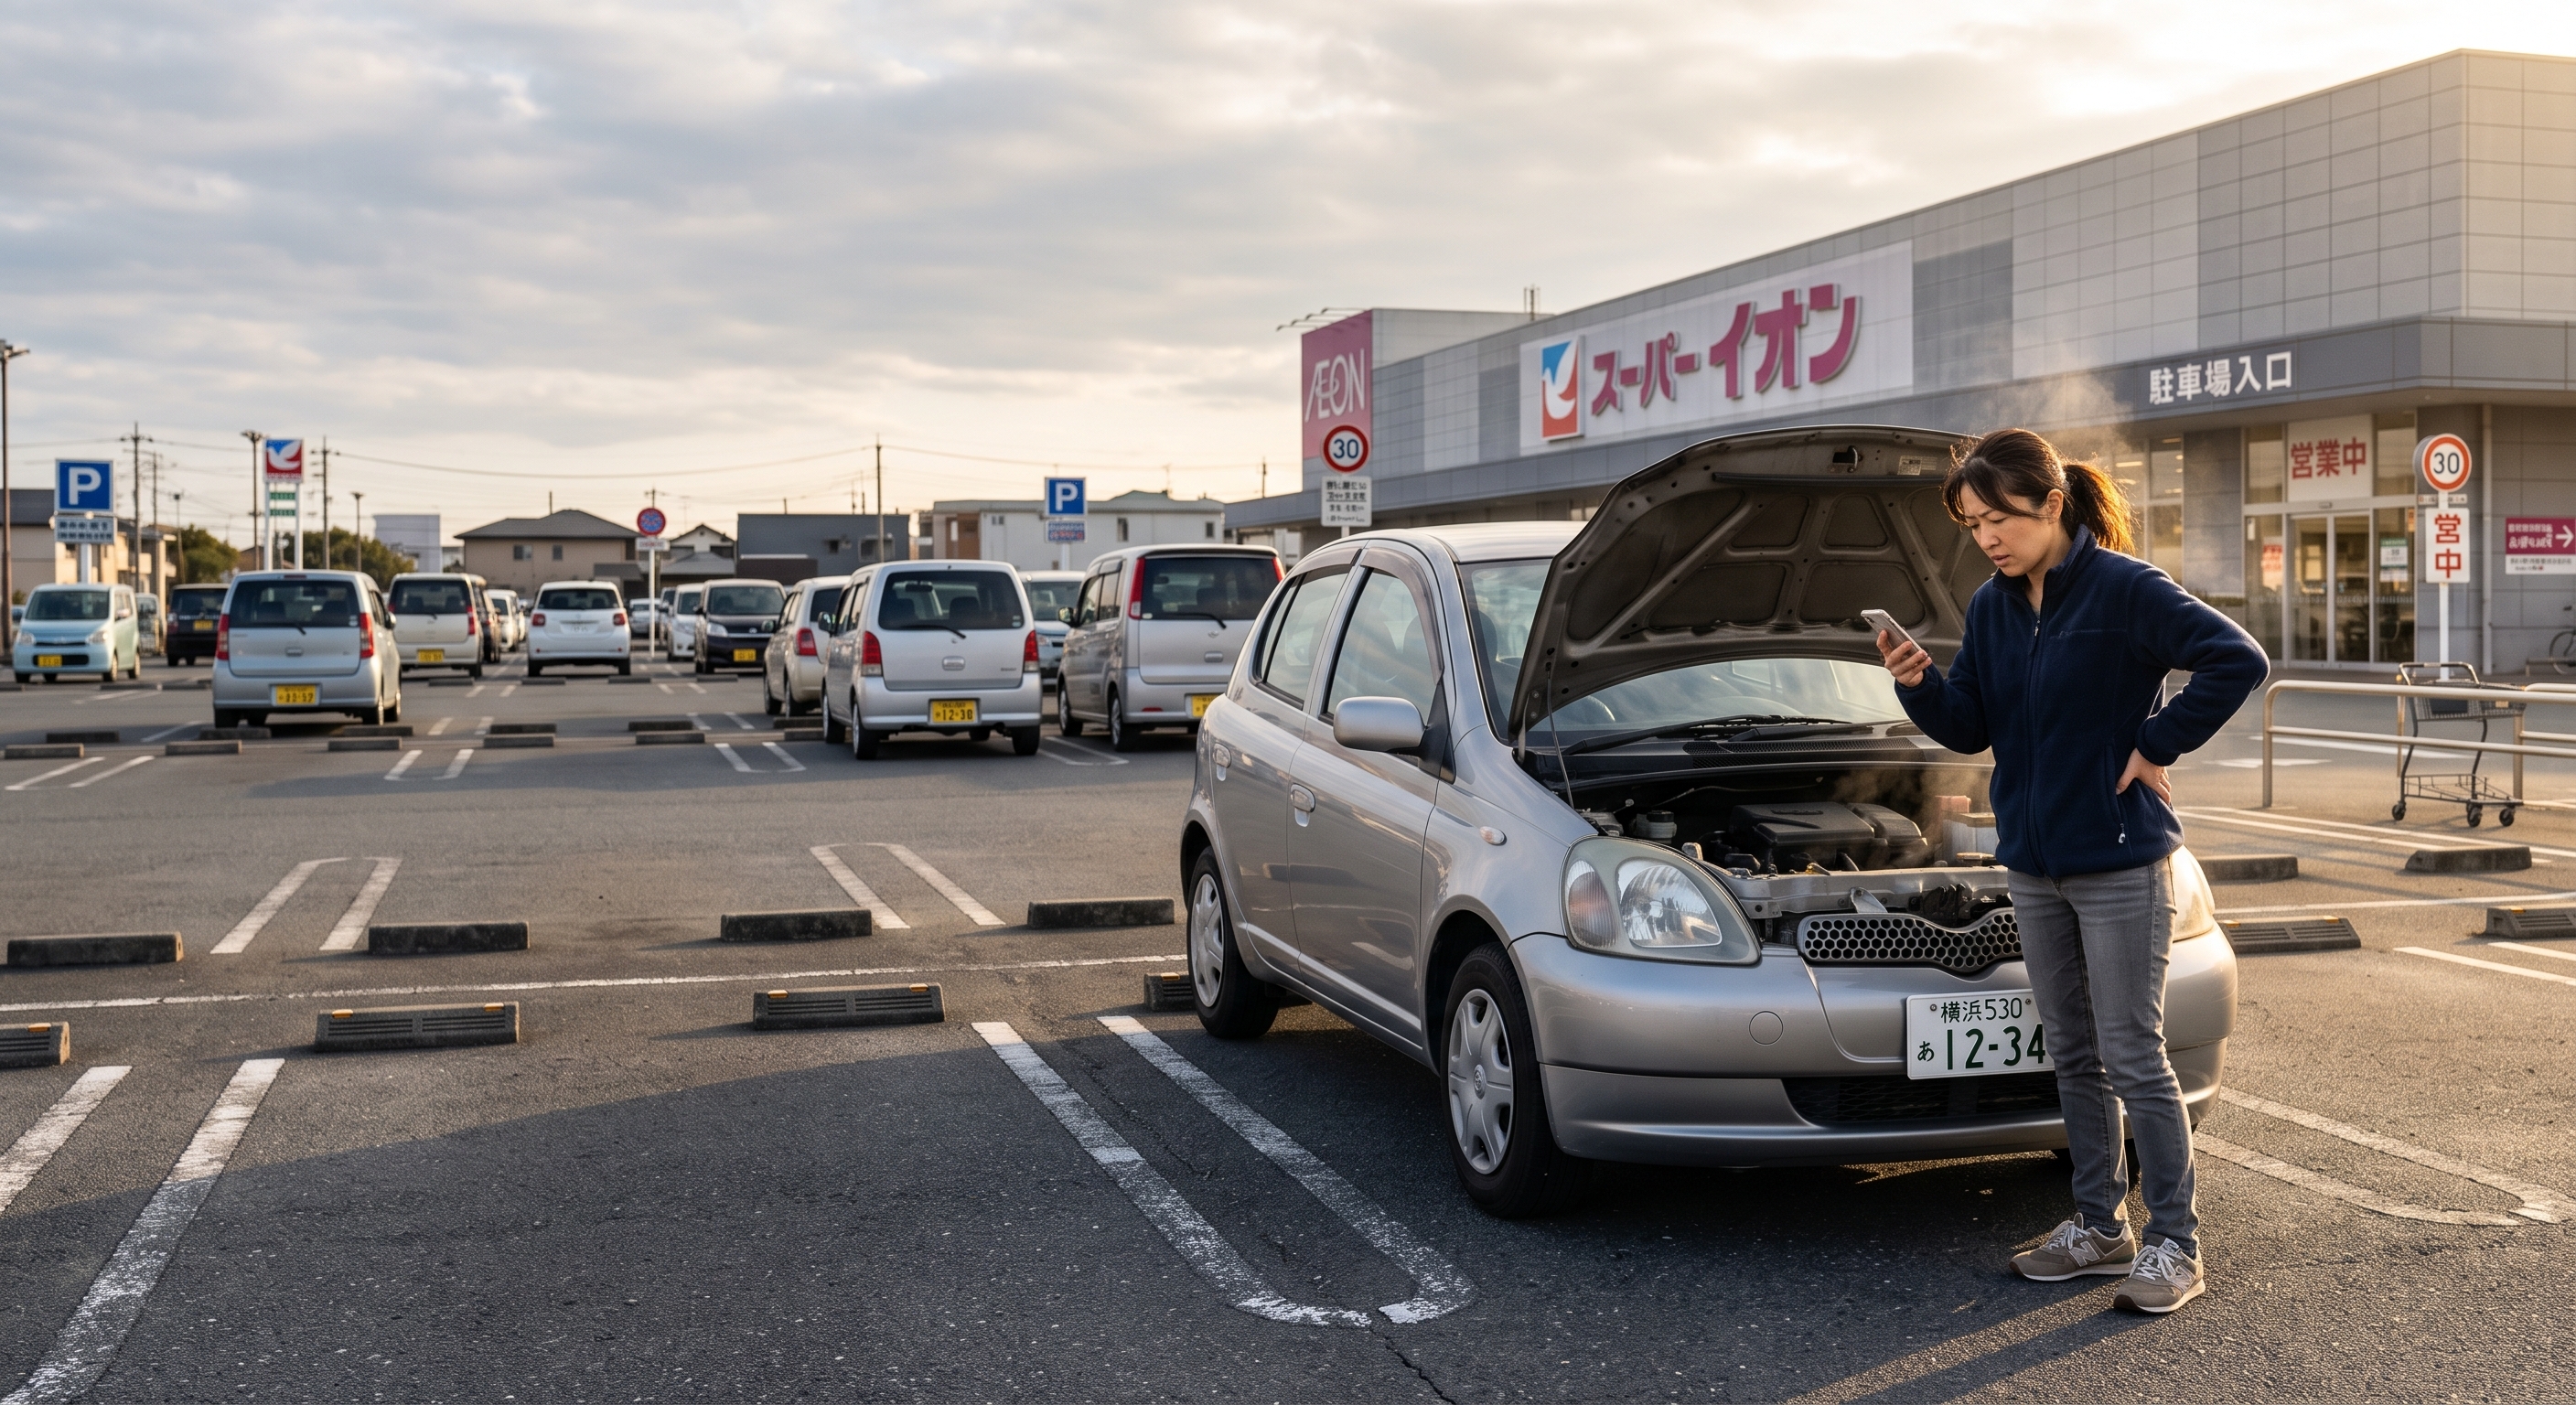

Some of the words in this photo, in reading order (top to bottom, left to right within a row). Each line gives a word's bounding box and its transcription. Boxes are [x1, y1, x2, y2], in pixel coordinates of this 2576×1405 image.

[2149, 351, 2292, 405] 駐車場入口
[1333, 439, 1359, 459] 30
[2291, 436, 2367, 479] 営業中
[2433, 452, 2460, 474] 30
[69, 467, 102, 506] P
[1056, 482, 1079, 511] P
[2434, 513, 2462, 579] 営中
[1940, 997, 2023, 1024] 横浜530
[1917, 1041, 1935, 1062] あ
[1947, 1024, 2046, 1070] 12-34
